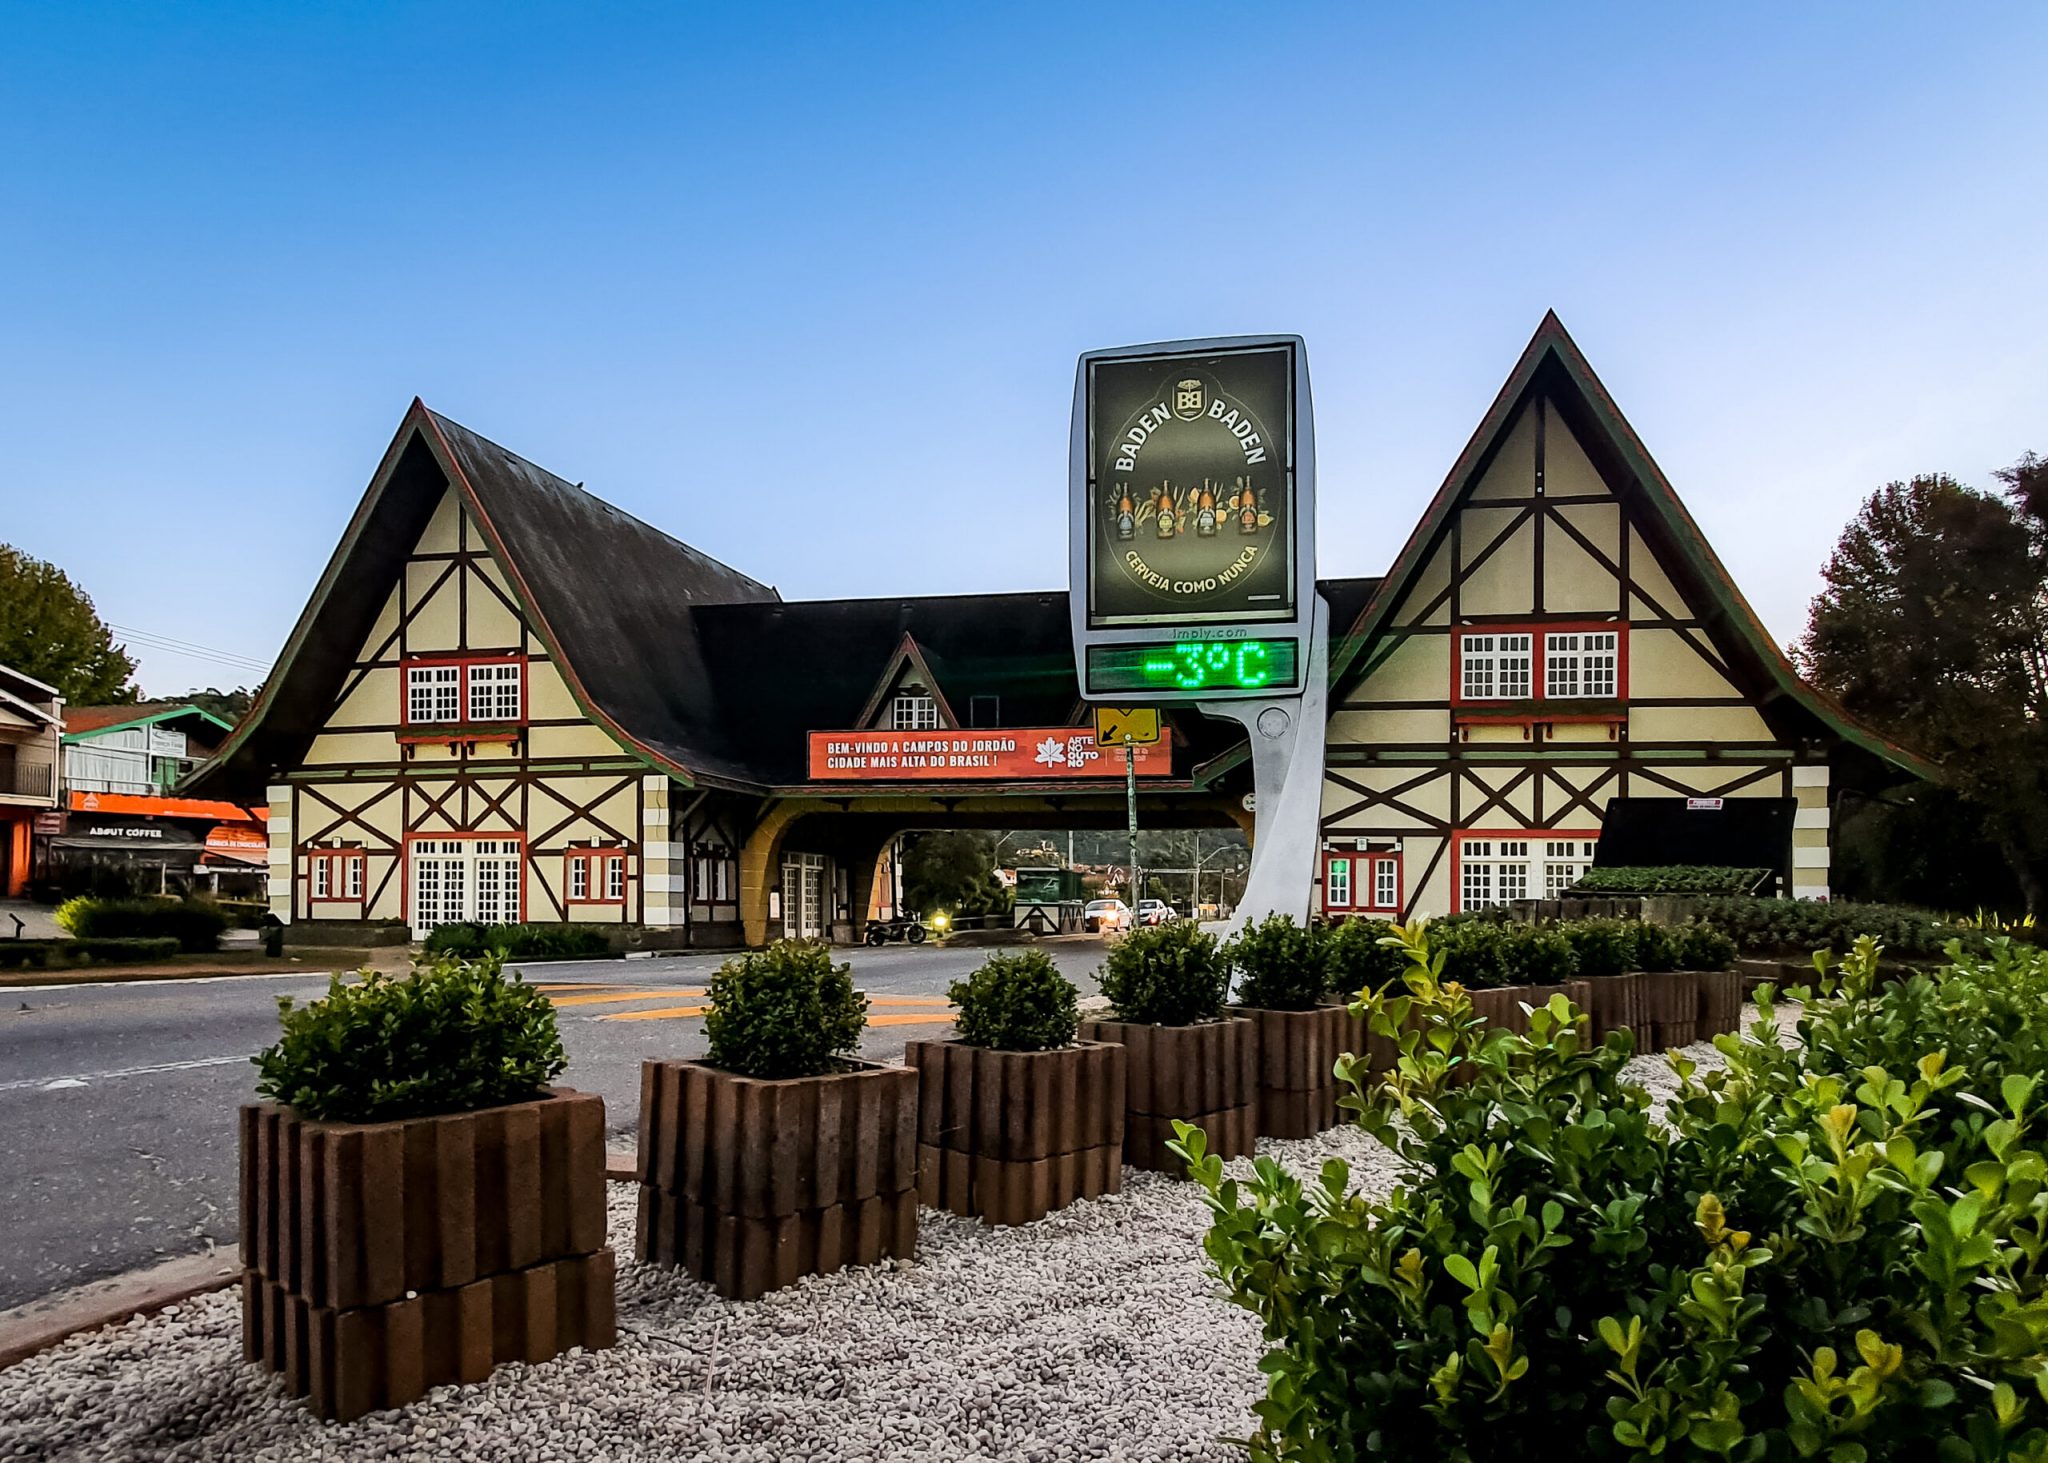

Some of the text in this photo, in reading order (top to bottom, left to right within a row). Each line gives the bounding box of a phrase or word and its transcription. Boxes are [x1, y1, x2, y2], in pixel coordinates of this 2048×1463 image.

[1115, 398, 1266, 471] BADEN BADEN
[1125, 546, 1258, 593] CERVEJA COMO NUNCA
[827, 737, 1015, 754] BEM-VINDO A CAMPOS DO JORDÃO
[1067, 736, 1095, 745] ARTE
[1067, 744, 1083, 752] NO
[827, 757, 867, 768] CIDADE
[870, 756, 897, 768] MAIS
[901, 756, 926, 767] ALTA
[930, 756, 945, 767] DO
[950, 755, 990, 767] BRASIL
[1067, 752, 1099, 760] OUTO
[1067, 759, 1085, 768] NO
